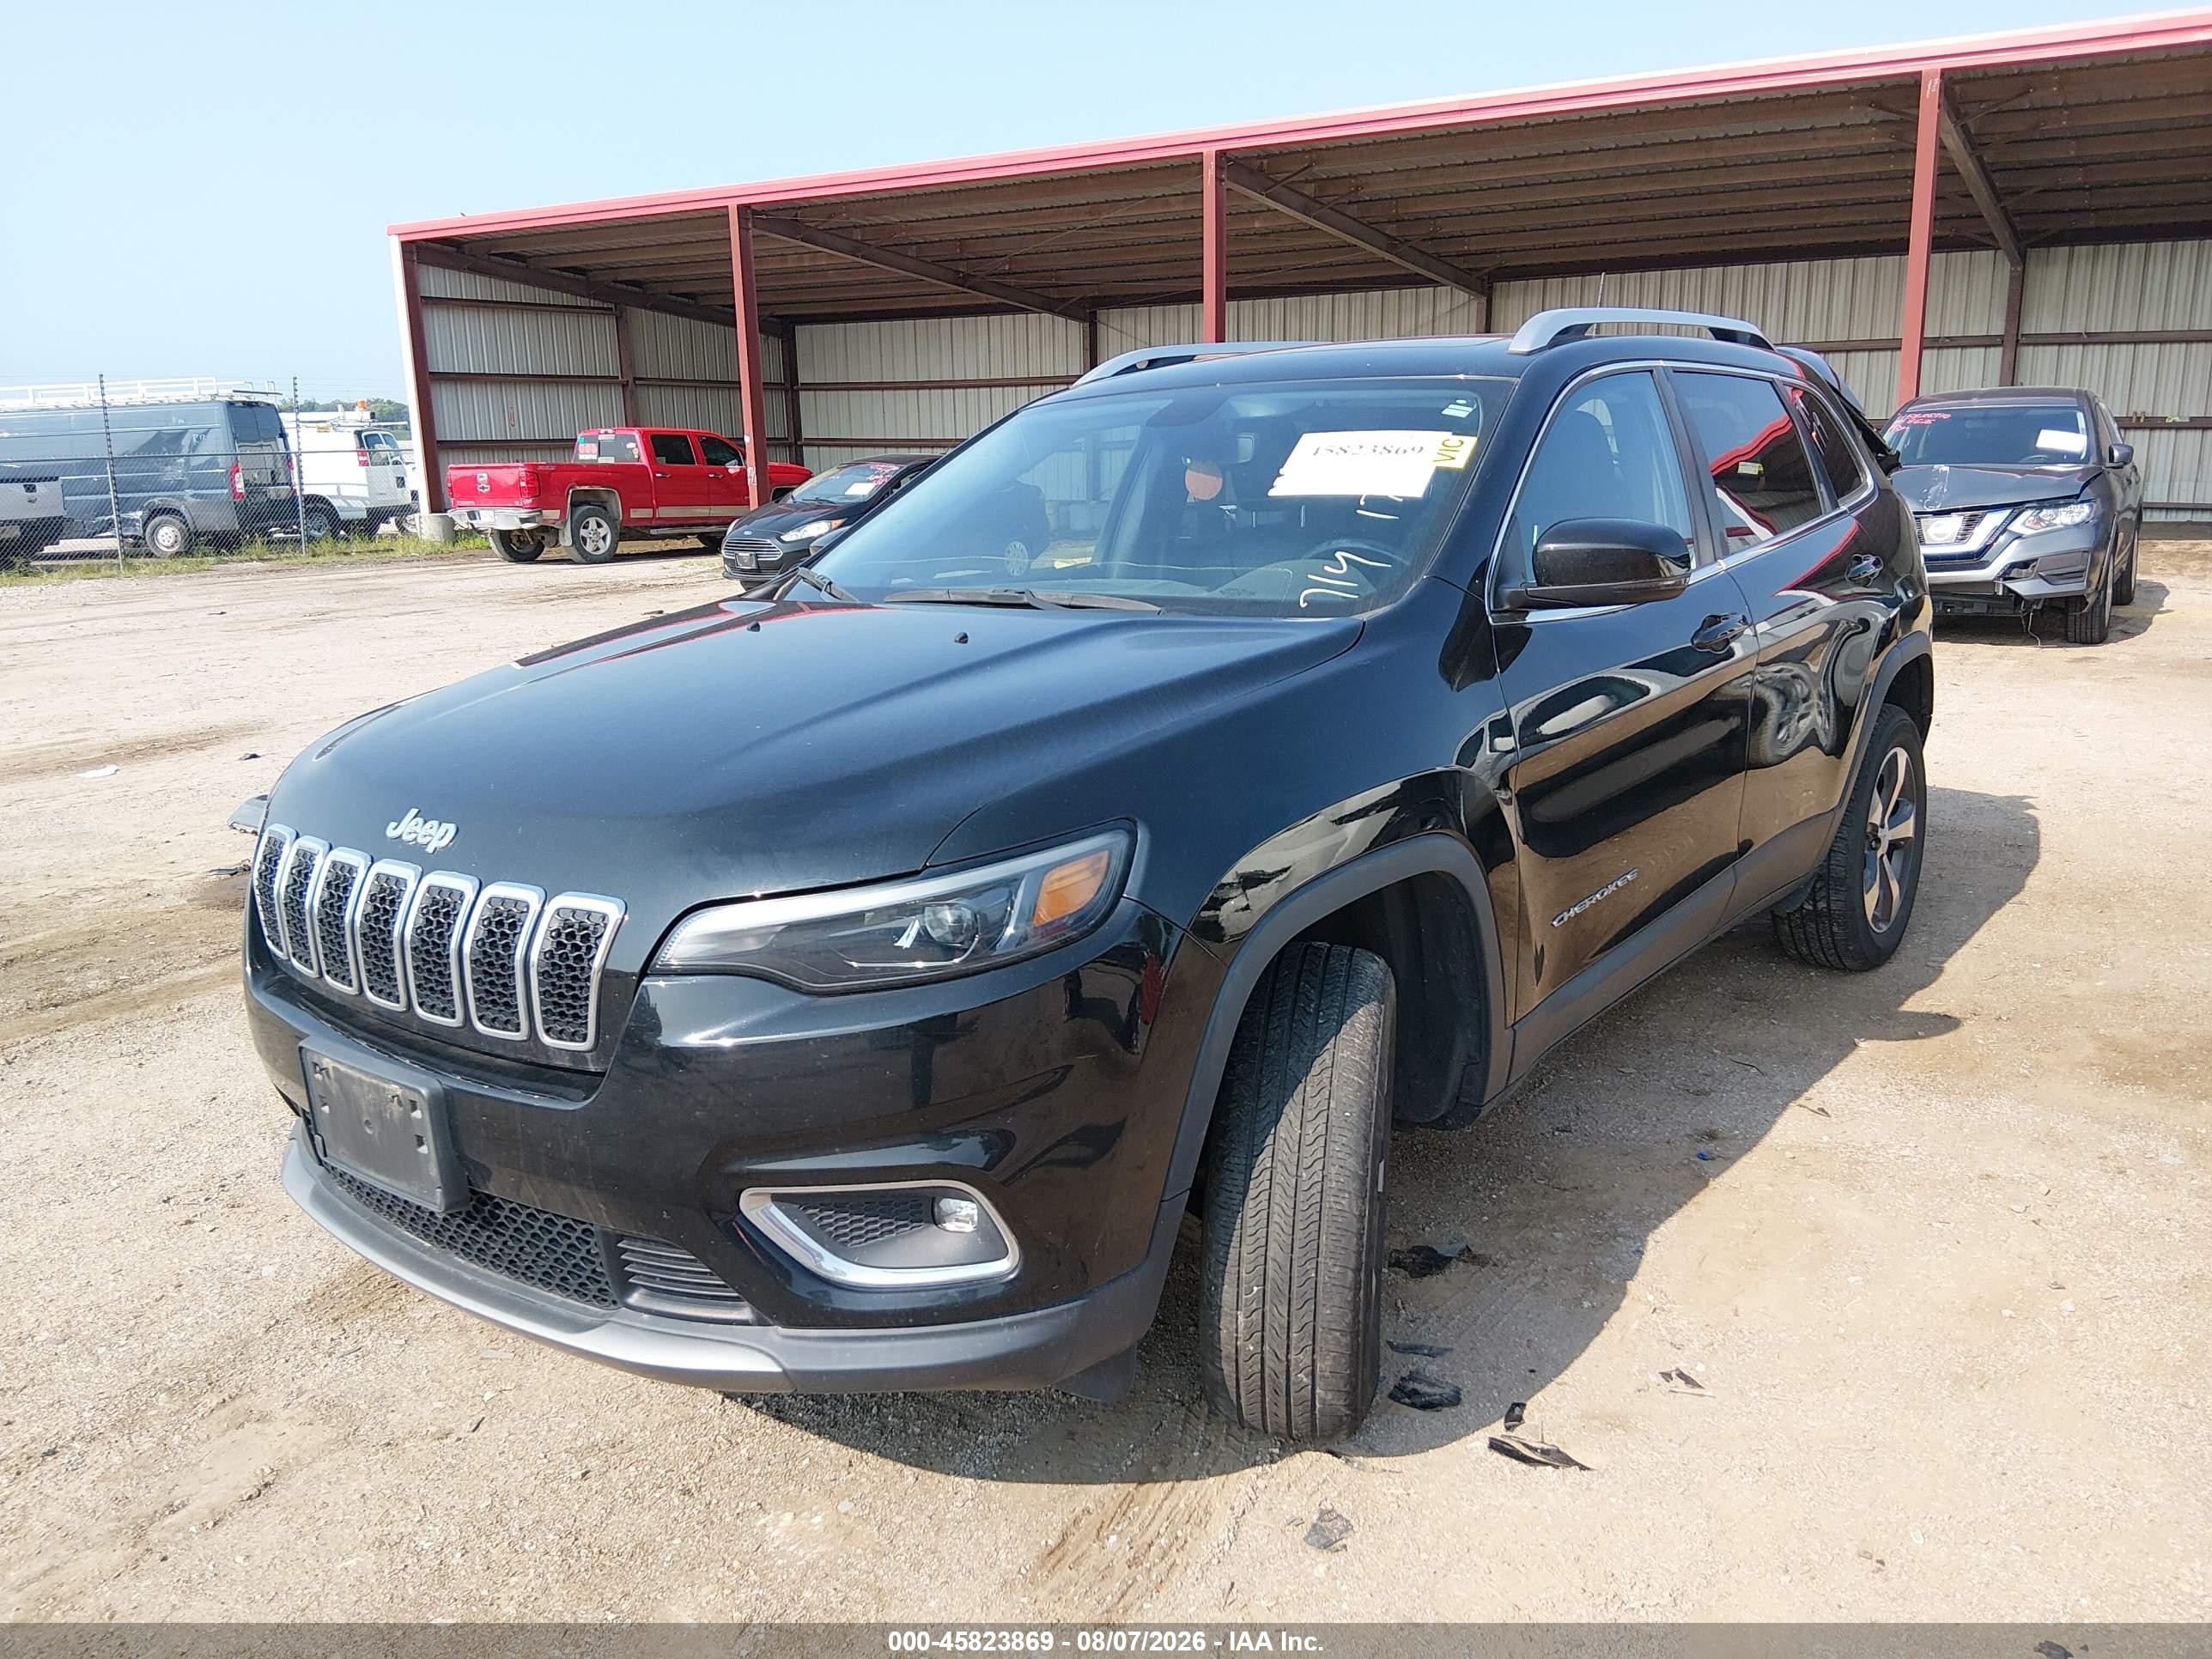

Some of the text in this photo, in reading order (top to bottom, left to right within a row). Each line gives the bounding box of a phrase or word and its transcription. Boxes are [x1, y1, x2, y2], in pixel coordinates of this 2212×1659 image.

[1431, 438, 1465, 463] VIC
[386, 807, 458, 854] Jeep
[1551, 866, 1640, 928] CHEROKEE
